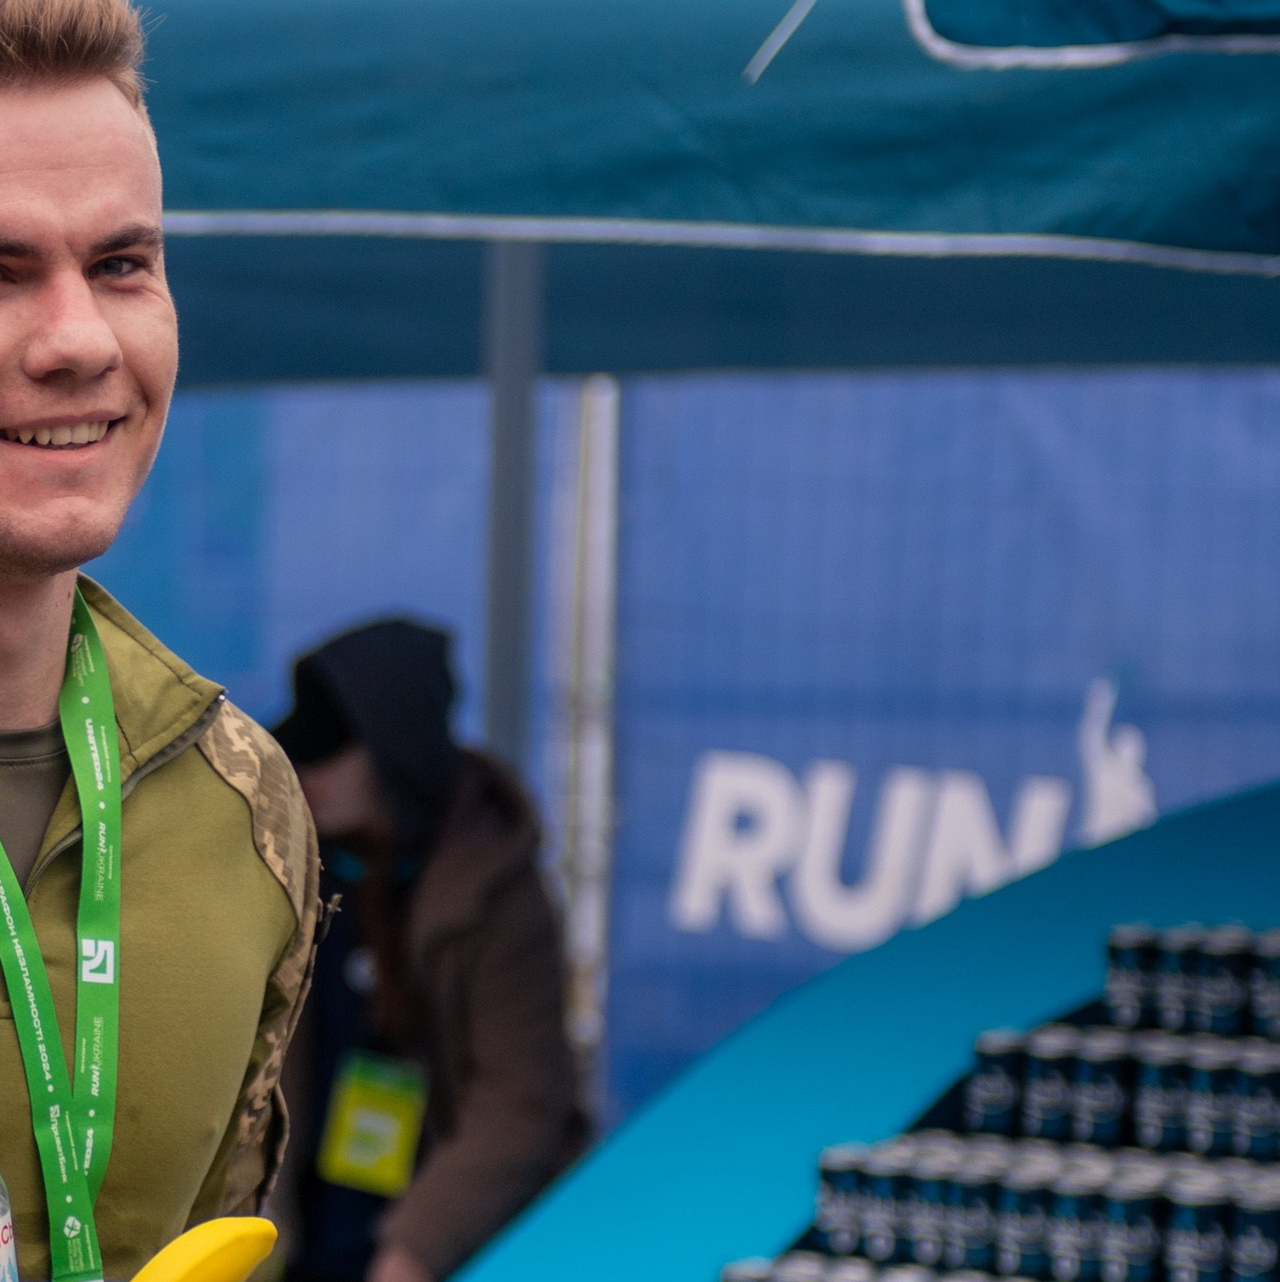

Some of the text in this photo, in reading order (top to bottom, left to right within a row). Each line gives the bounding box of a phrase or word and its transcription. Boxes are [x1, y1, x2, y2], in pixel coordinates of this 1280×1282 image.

[98, 822, 107, 849] RUN
[670, 747, 1073, 953] RUN
[12, 938, 44, 1042] НЕЗЛАМНОСТІ
[38, 1044, 52, 1081] 2024
[91, 1070, 100, 1096] RUN
